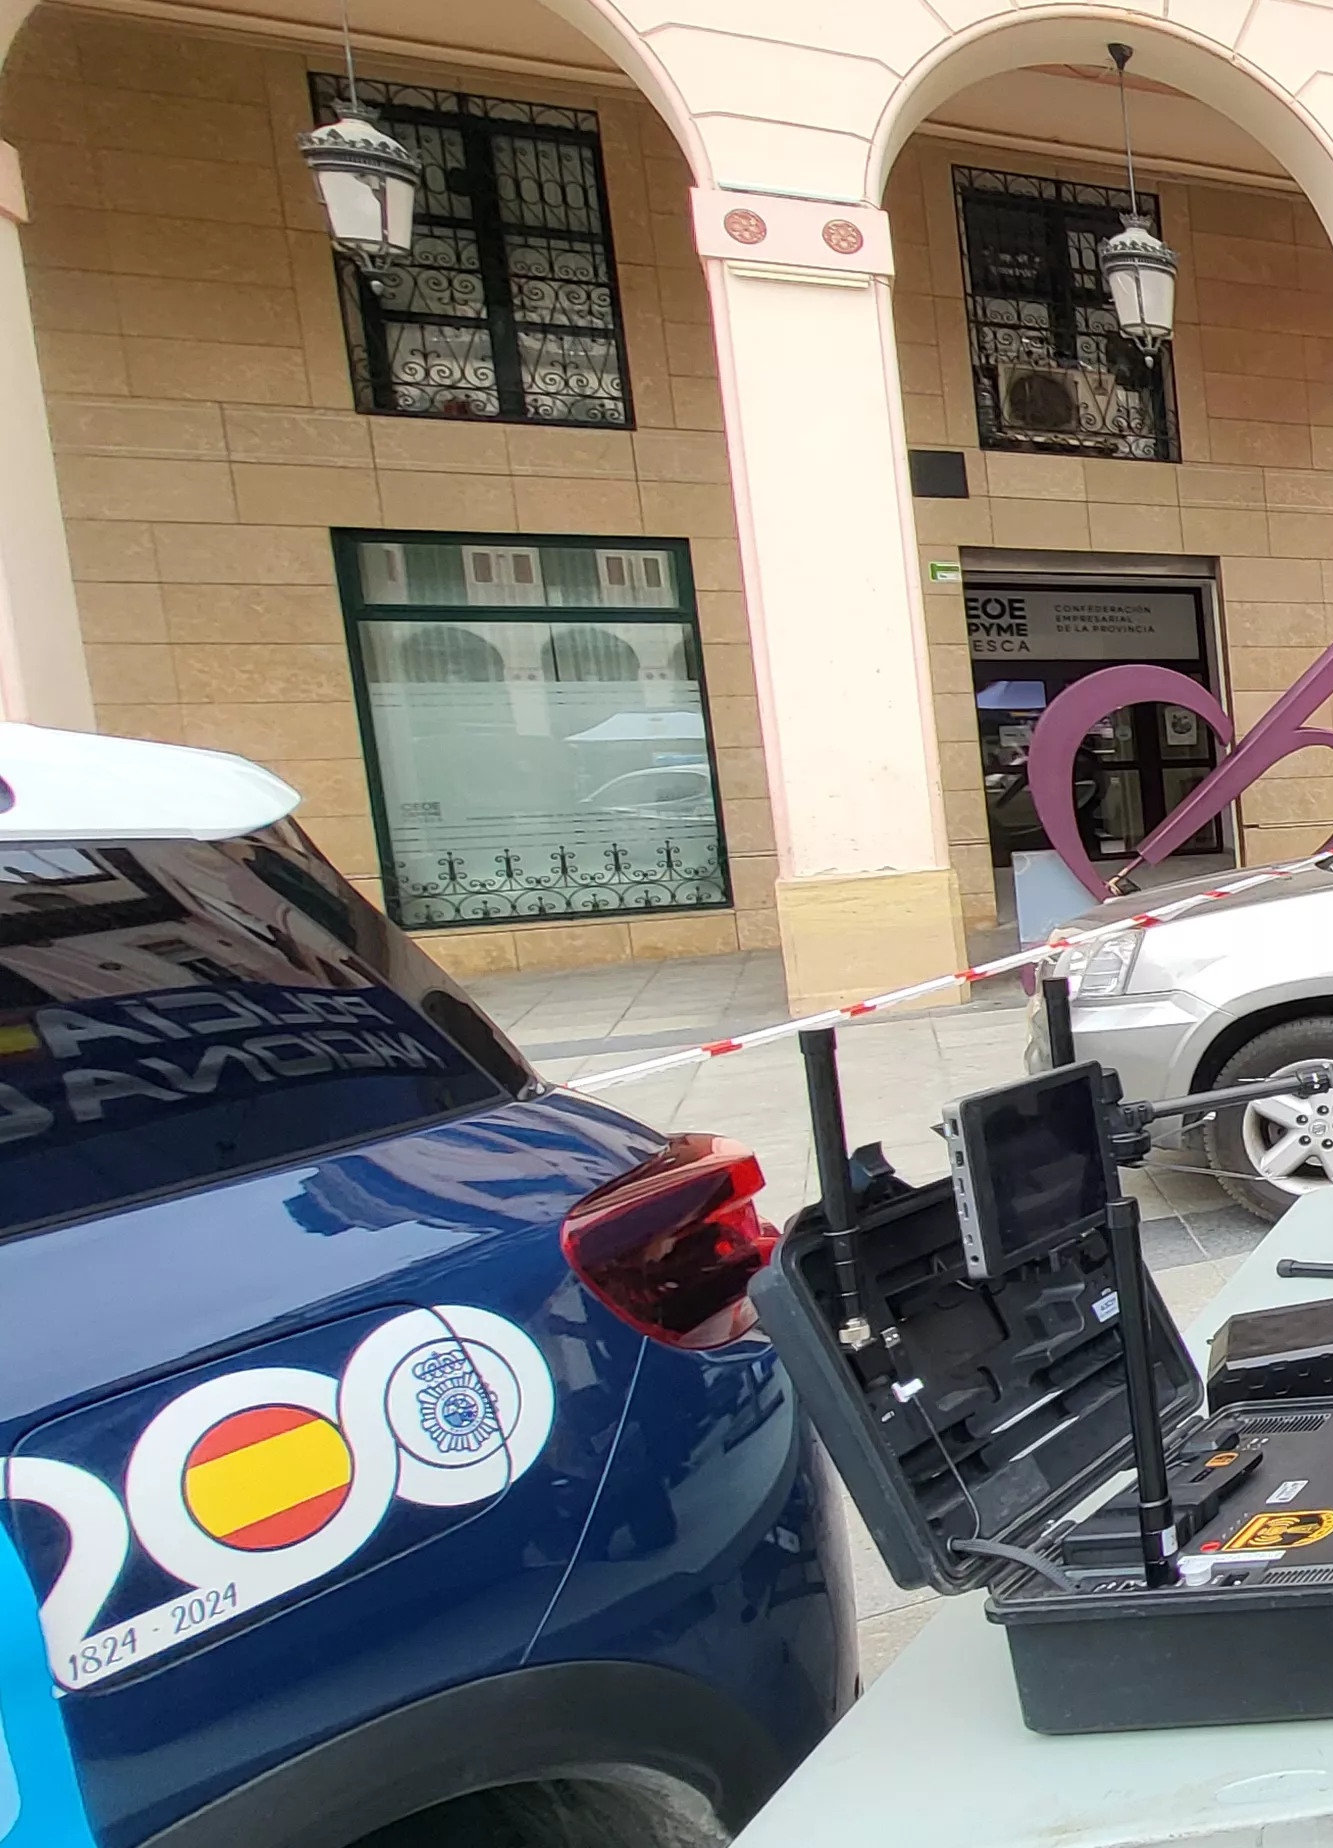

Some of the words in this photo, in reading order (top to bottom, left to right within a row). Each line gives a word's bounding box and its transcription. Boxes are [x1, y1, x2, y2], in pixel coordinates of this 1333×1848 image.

[966, 597, 1027, 621] EOE
[969, 622, 1029, 638] PYME
[974, 639, 1031, 653] ESCA
[67, 1627, 137, 1682] 1824
[170, 1582, 239, 1636] 2024
